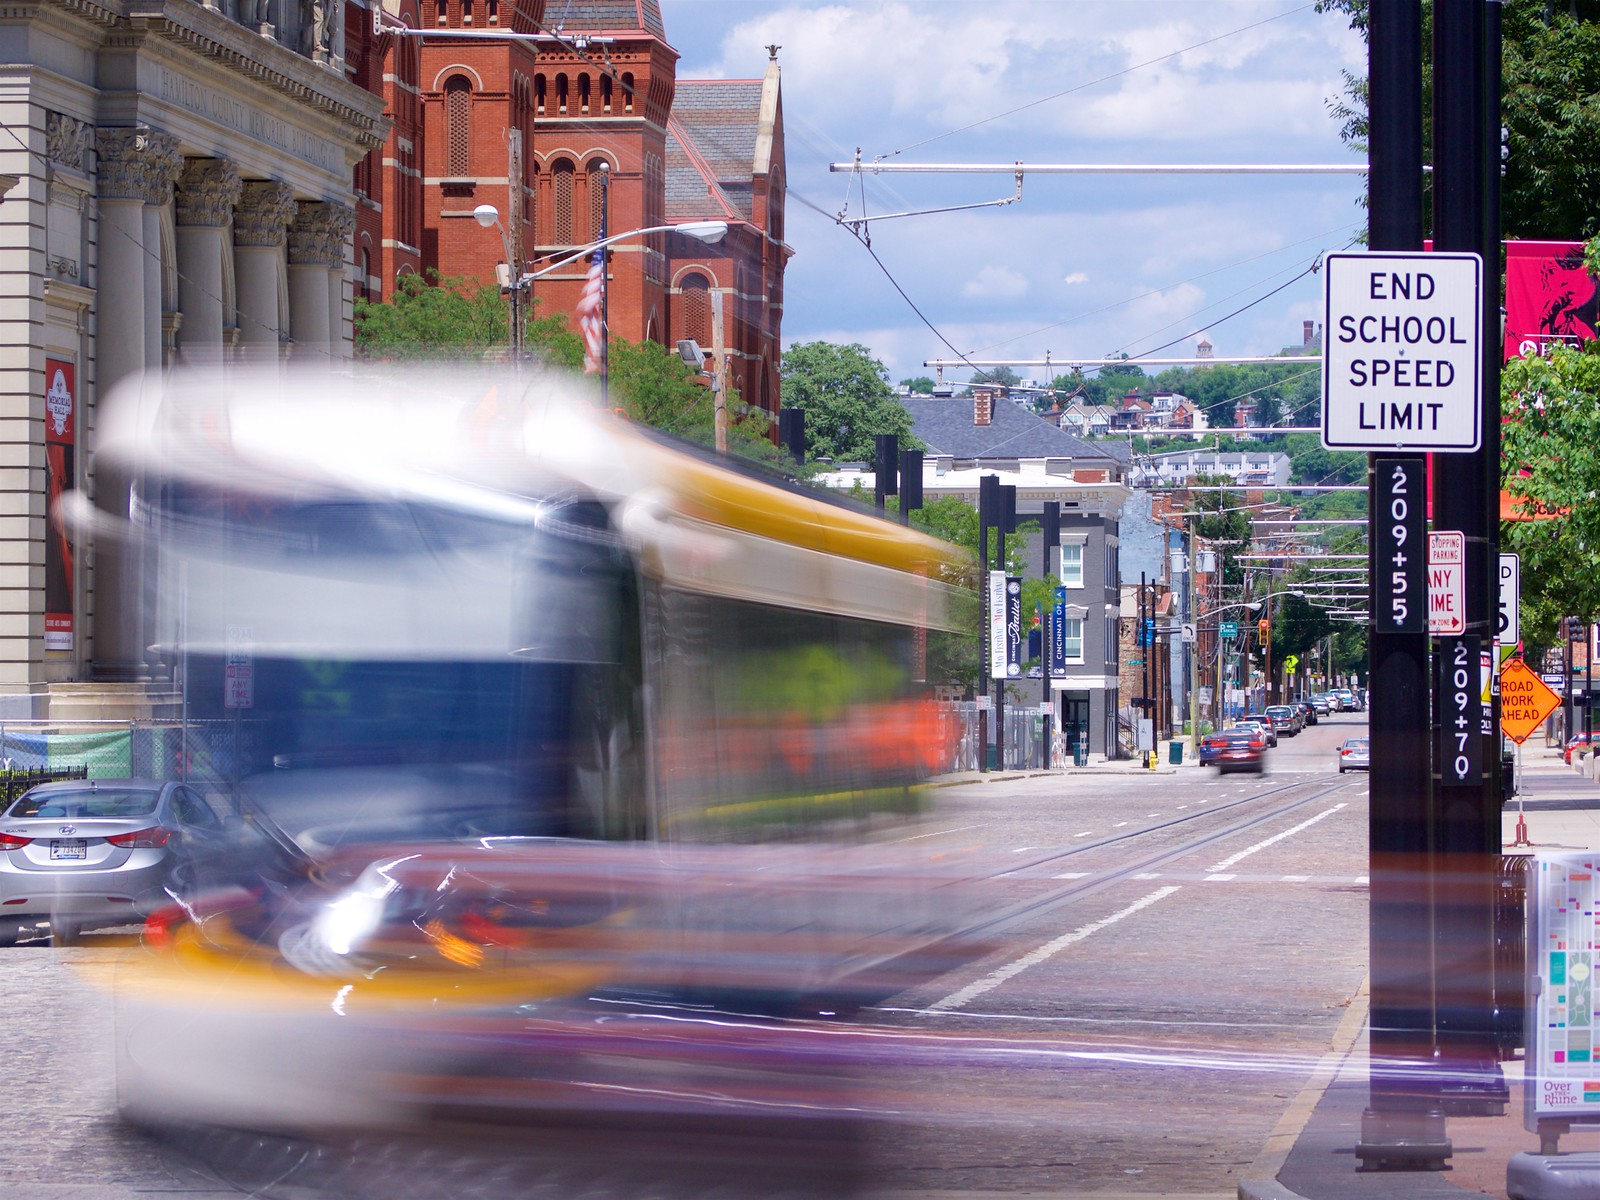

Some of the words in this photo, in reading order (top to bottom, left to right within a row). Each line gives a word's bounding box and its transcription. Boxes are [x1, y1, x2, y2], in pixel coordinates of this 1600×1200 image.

[162, 71, 207, 112] HAMILTON
[212, 94, 245, 130] COUNTY
[249, 111, 288, 149] MEMORIAL
[1370, 272, 1435, 300] END
[1338, 315, 1467, 344] SCHOOL
[1349, 359, 1455, 387] SPEED
[1359, 402, 1443, 430] LIMIT
[1391, 471, 1408, 620] 209+55
[1431, 538, 1459, 548] STOPPING
[1433, 550, 1458, 560] PARKING
[1430, 593, 1454, 612] IME
[1008, 597, 1020, 645] Ballet
[1437, 618, 1450, 626] ZONE
[231, 690, 247, 698] TIME
[1501, 681, 1534, 692] ROAD
[1502, 695, 1534, 706] WORK
[1453, 647, 1469, 775] 209+70
[1544, 1080, 1571, 1091] Over
[1544, 1092, 1577, 1107] Rhine
